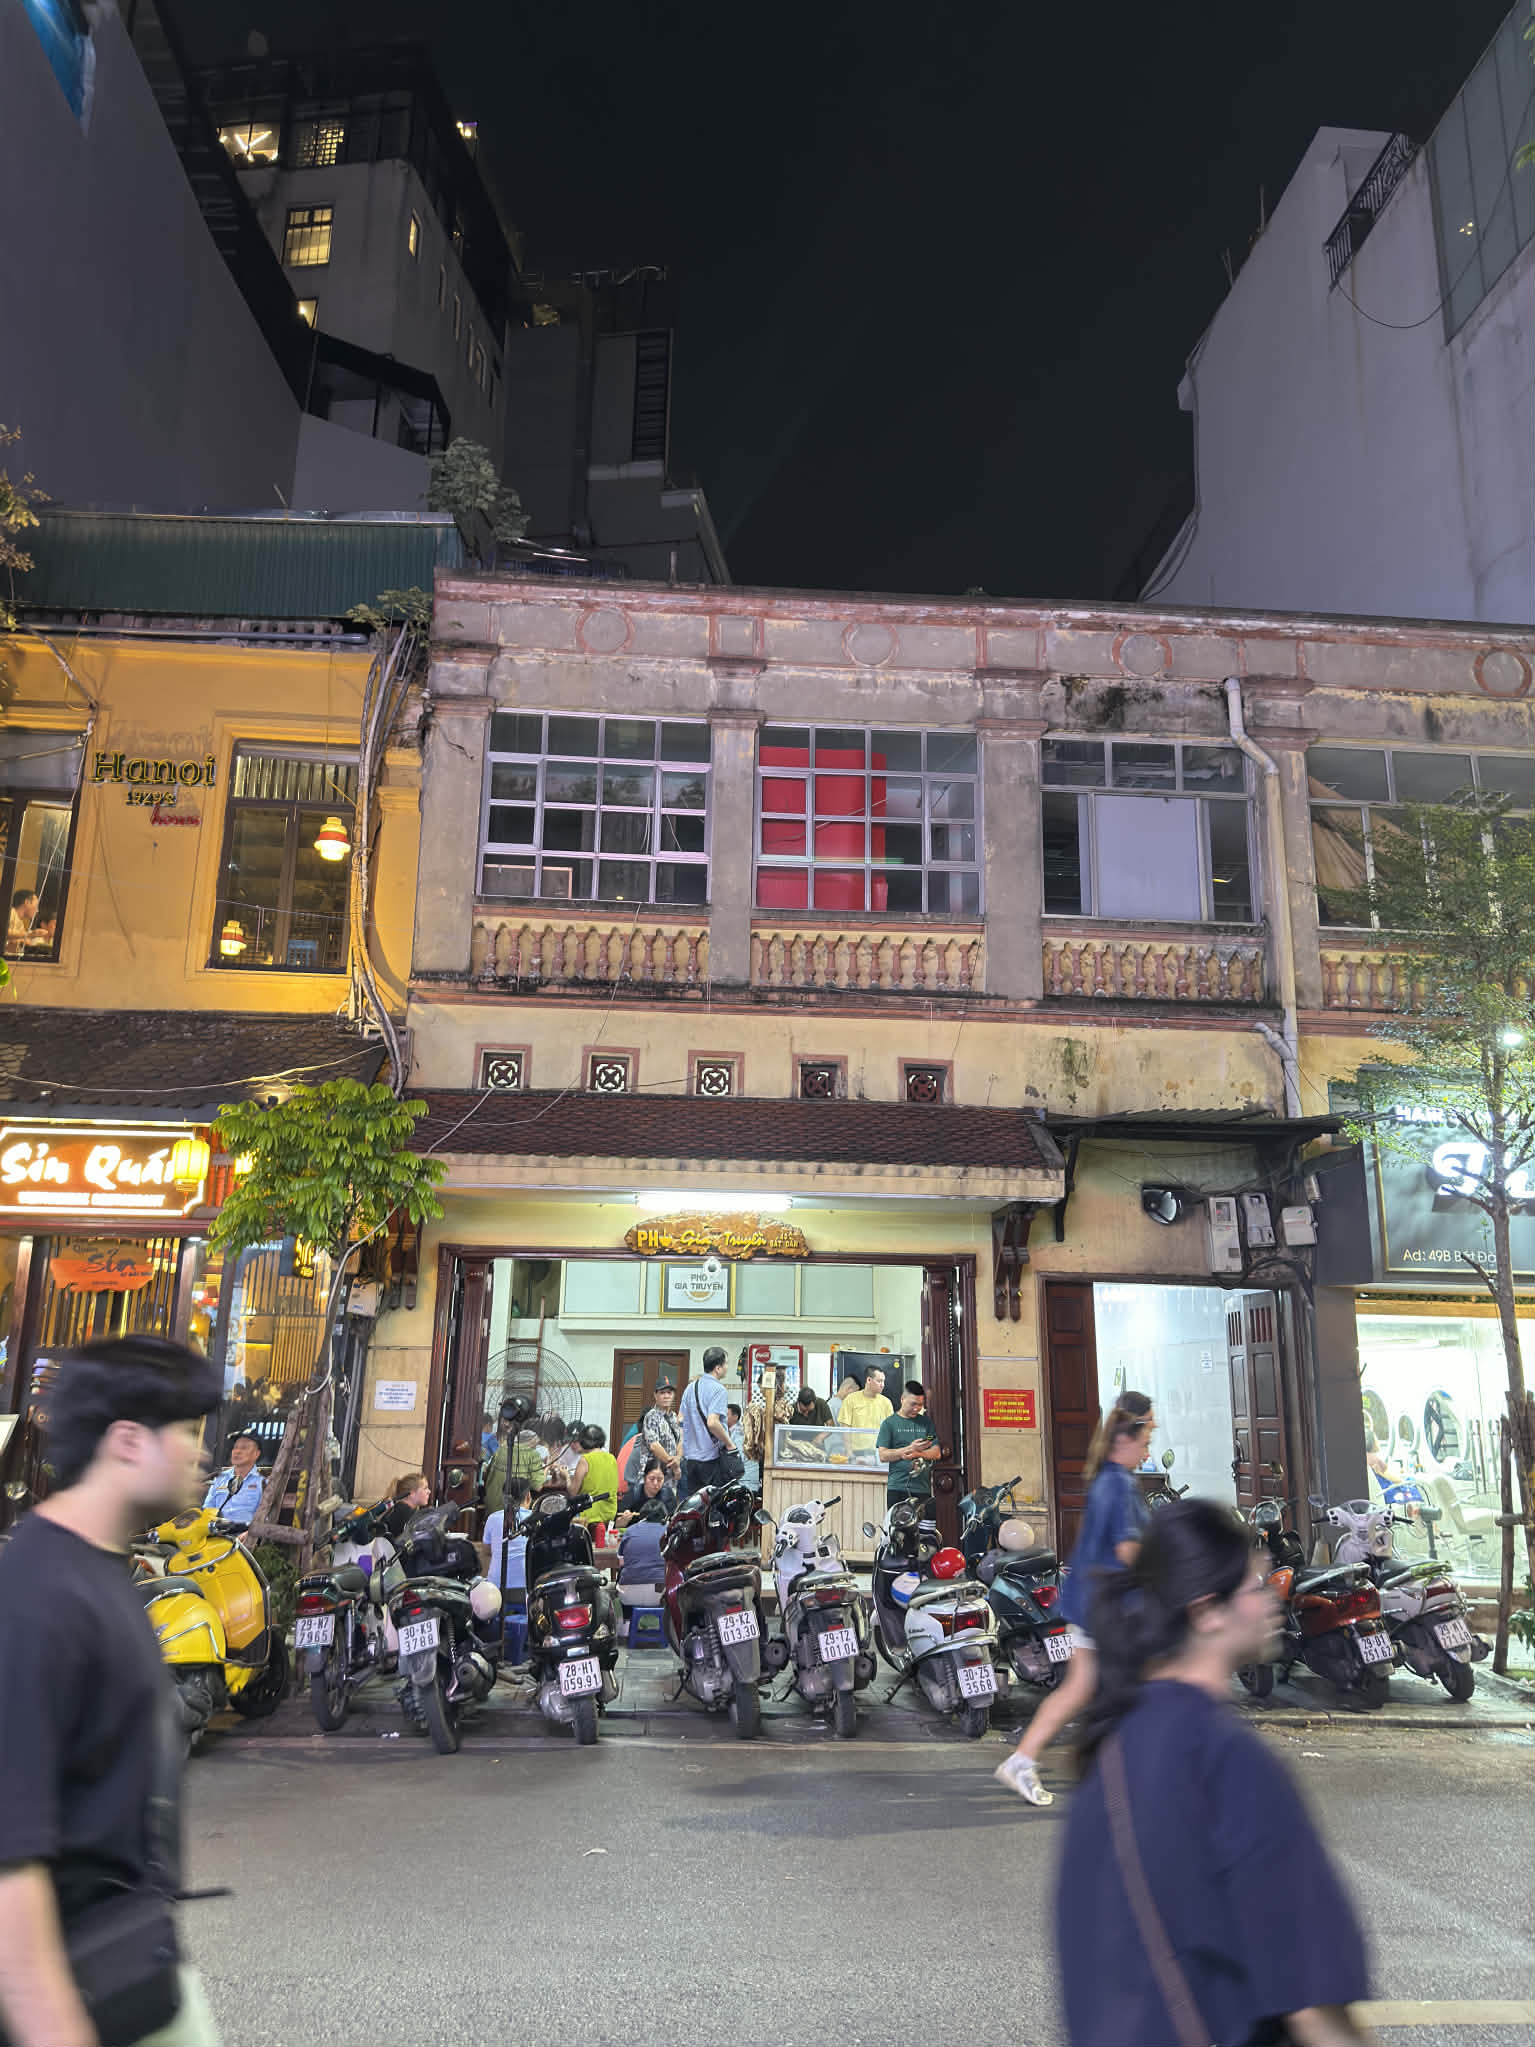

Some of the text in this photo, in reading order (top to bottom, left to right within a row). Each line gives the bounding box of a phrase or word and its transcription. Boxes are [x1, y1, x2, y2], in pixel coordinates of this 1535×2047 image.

[91, 751, 217, 787] Hanoi
[1403, 1249, 1426, 1262] Ad:
[1429, 1250, 1451, 1263] 49B
[404, 1635, 434, 1653] 3788
[563, 1673, 598, 1691] 059.91
